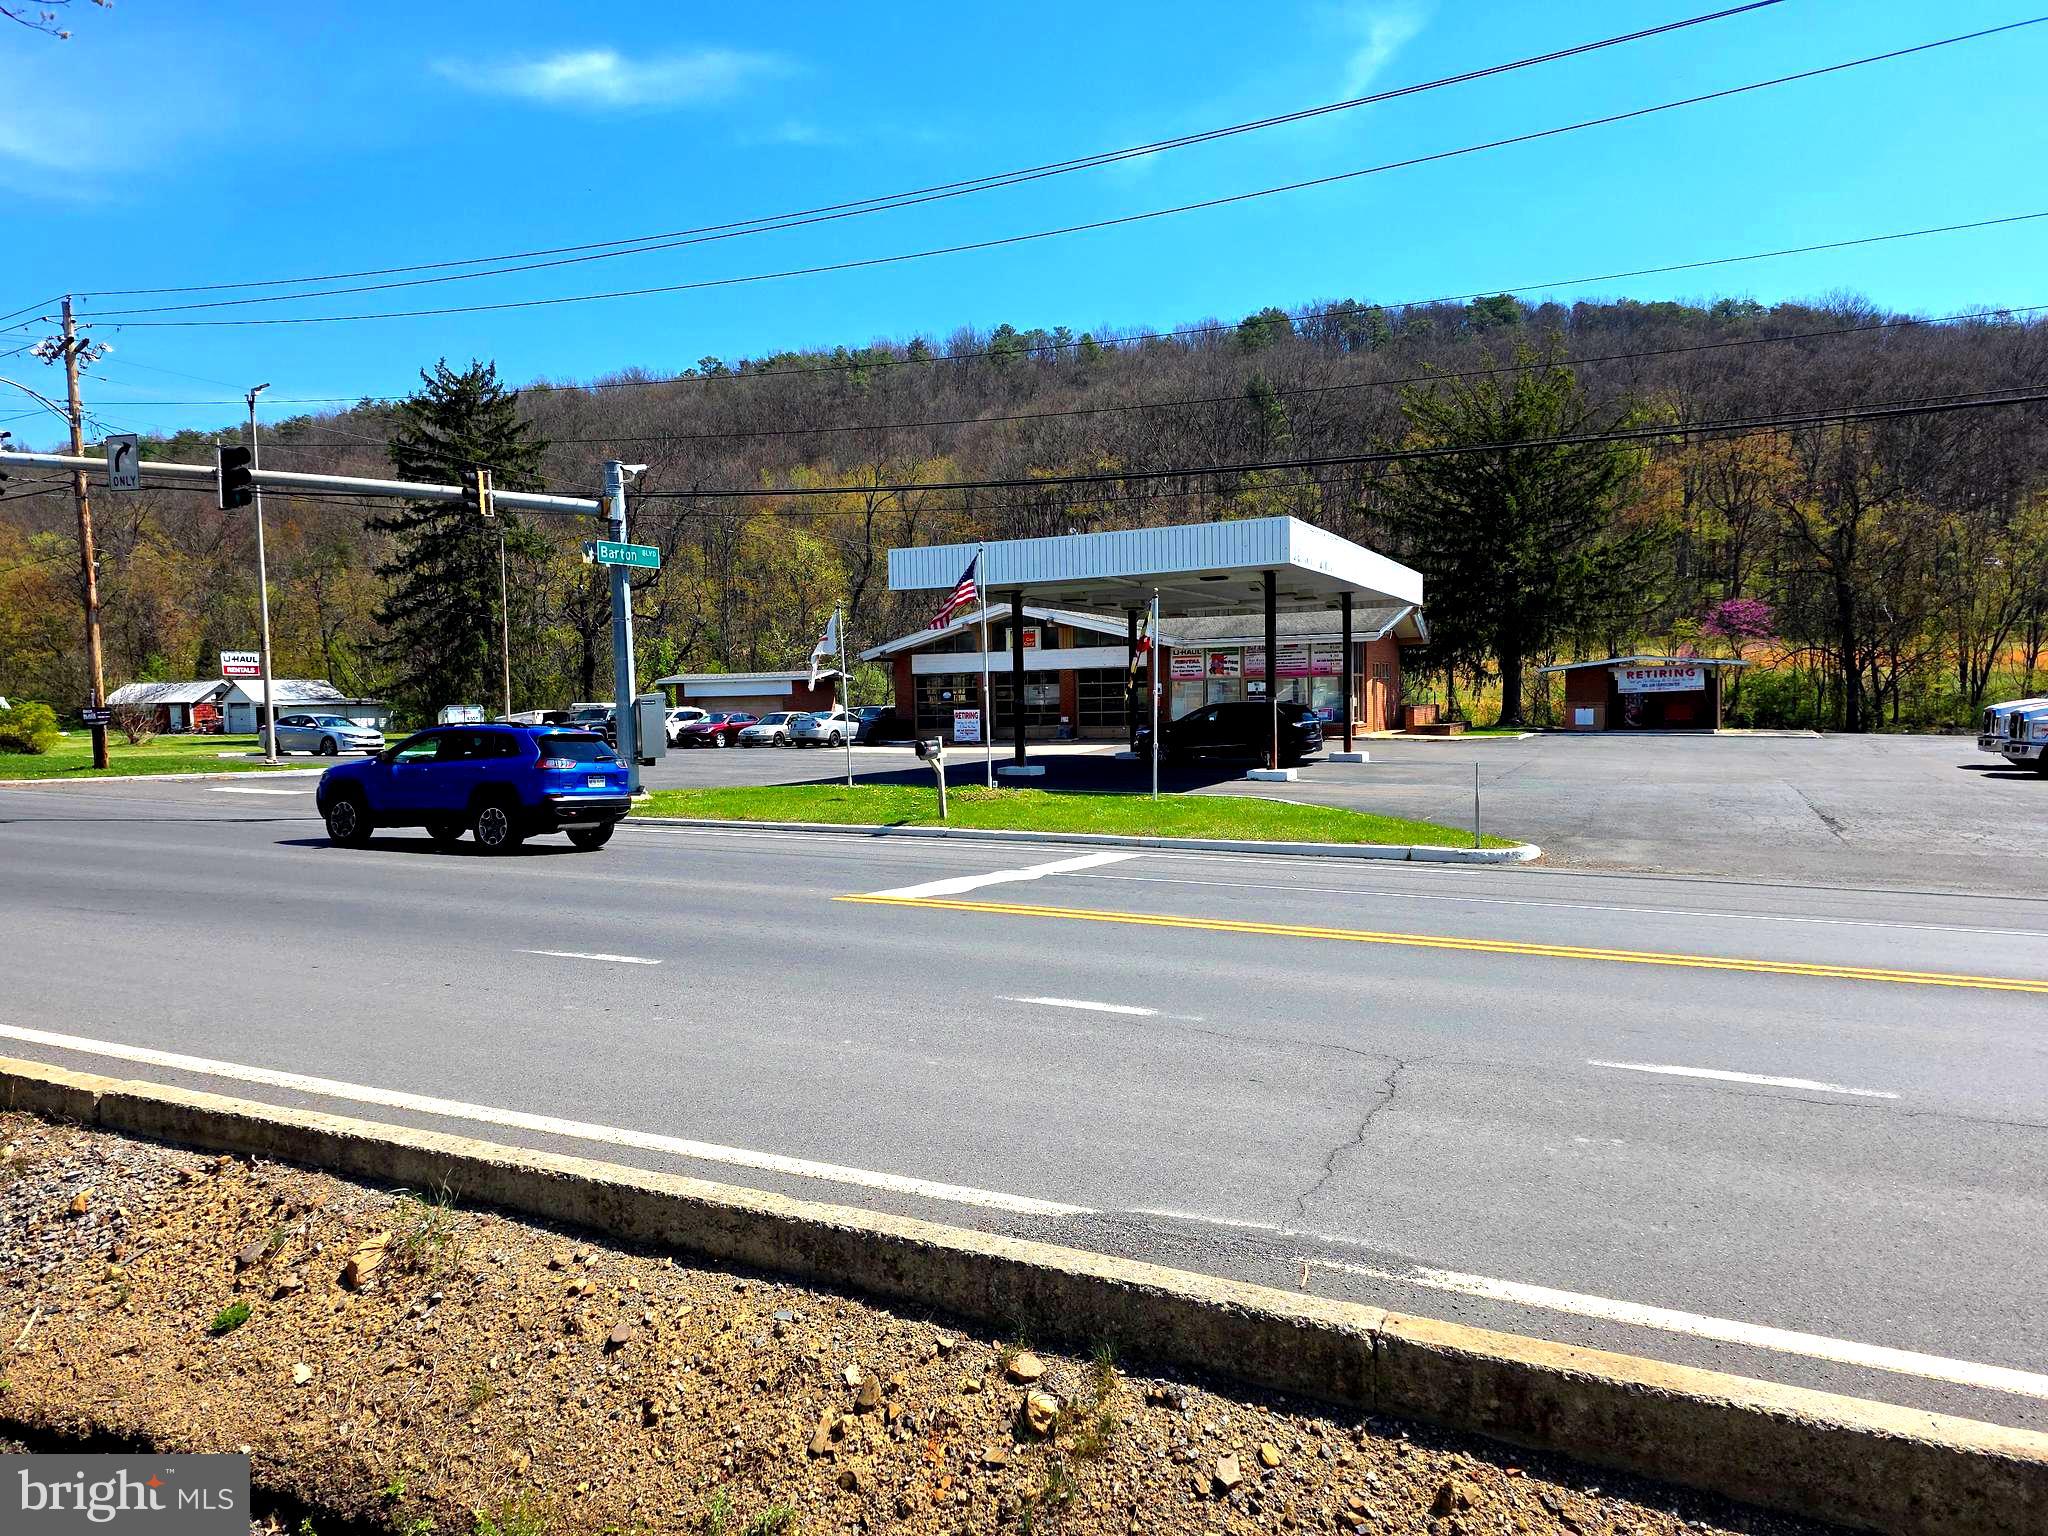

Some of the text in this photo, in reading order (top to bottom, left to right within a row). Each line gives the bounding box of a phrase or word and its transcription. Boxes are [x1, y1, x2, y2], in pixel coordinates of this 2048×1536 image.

[113, 475, 136, 487] ONLY
[600, 545, 657, 561] Barton BLVD
[1626, 668, 1696, 679] RETIRING
[955, 711, 978, 719] RETIRING
